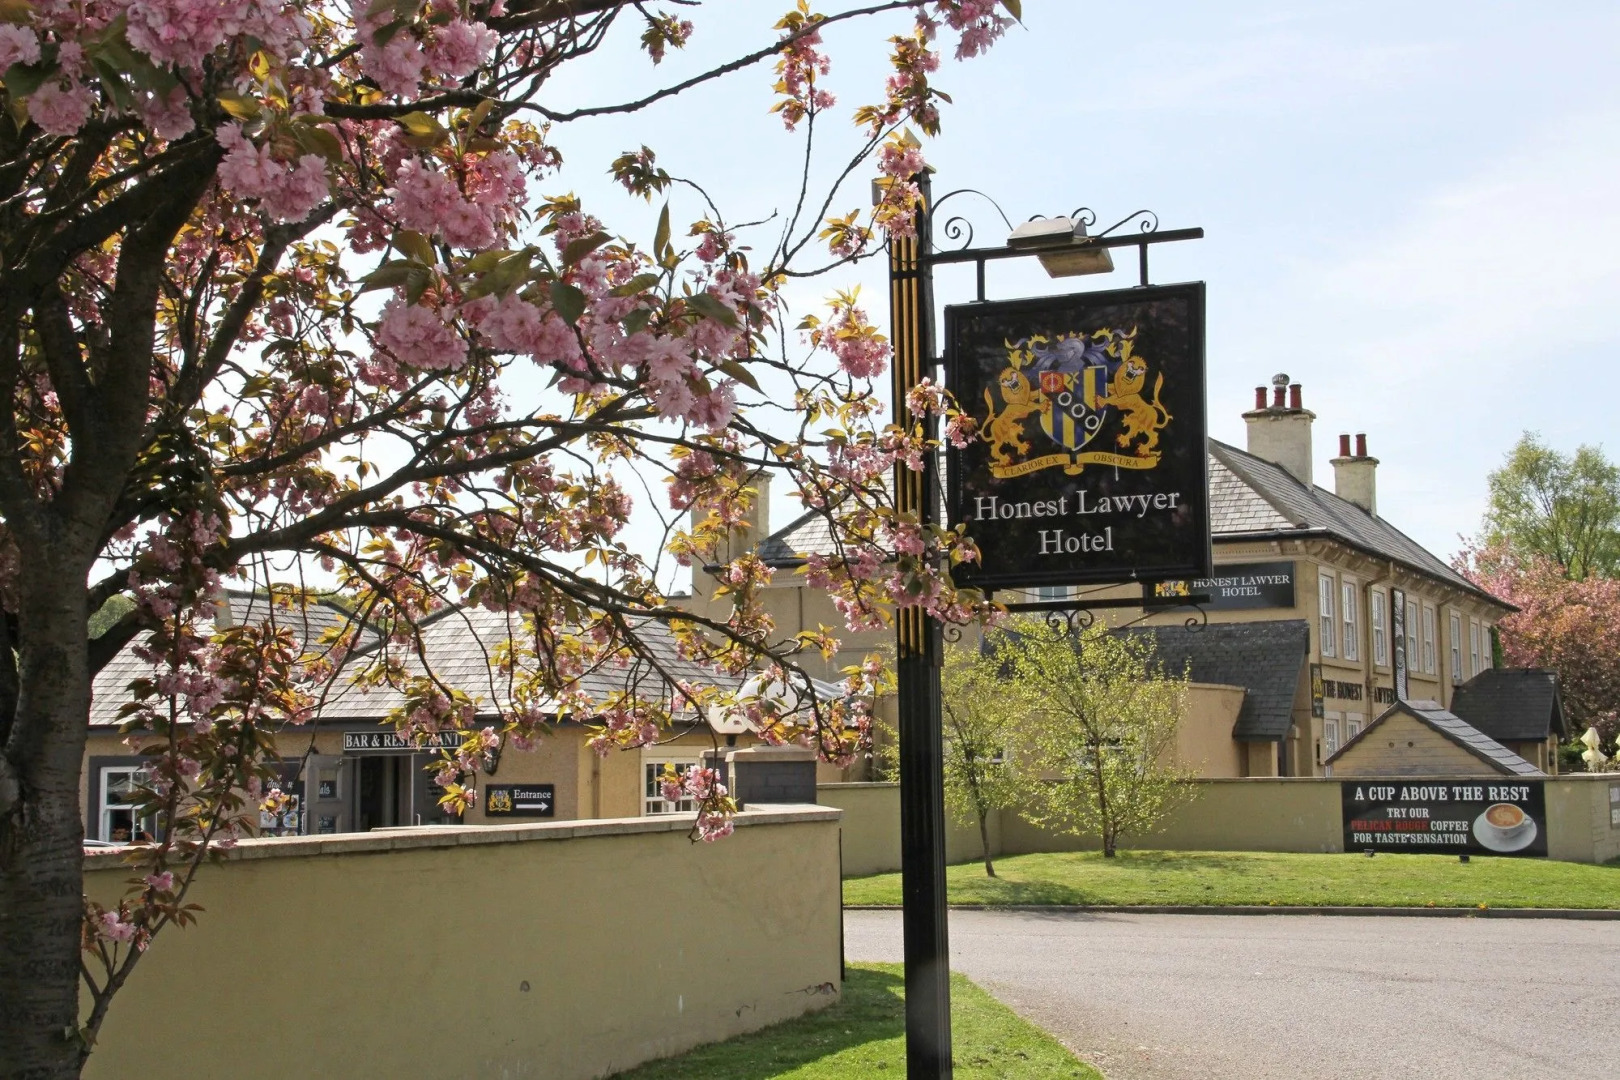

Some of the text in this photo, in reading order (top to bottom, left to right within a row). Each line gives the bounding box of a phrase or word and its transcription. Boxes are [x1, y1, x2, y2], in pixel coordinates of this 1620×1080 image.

[1046, 456, 1060, 466] EX
[1093, 453, 1139, 467] OBSCURA
[974, 490, 1180, 521] Honest Lawyer
[1038, 527, 1114, 554] Hotel
[1193, 575, 1290, 588] HONEST LAWYER
[1222, 587, 1261, 597] HOTEL
[345, 734, 369, 747] BAR
[371, 734, 380, 747] &
[513, 789, 552, 799] Entrance
[1355, 787, 1530, 801] A CUP ABOVE THE REST
[1387, 808, 1430, 818] TRY OUR
[1351, 820, 1469, 831] PELICAN ROUGE COFFEE
[1353, 833, 1468, 844] FOR TASTE SENSATION
